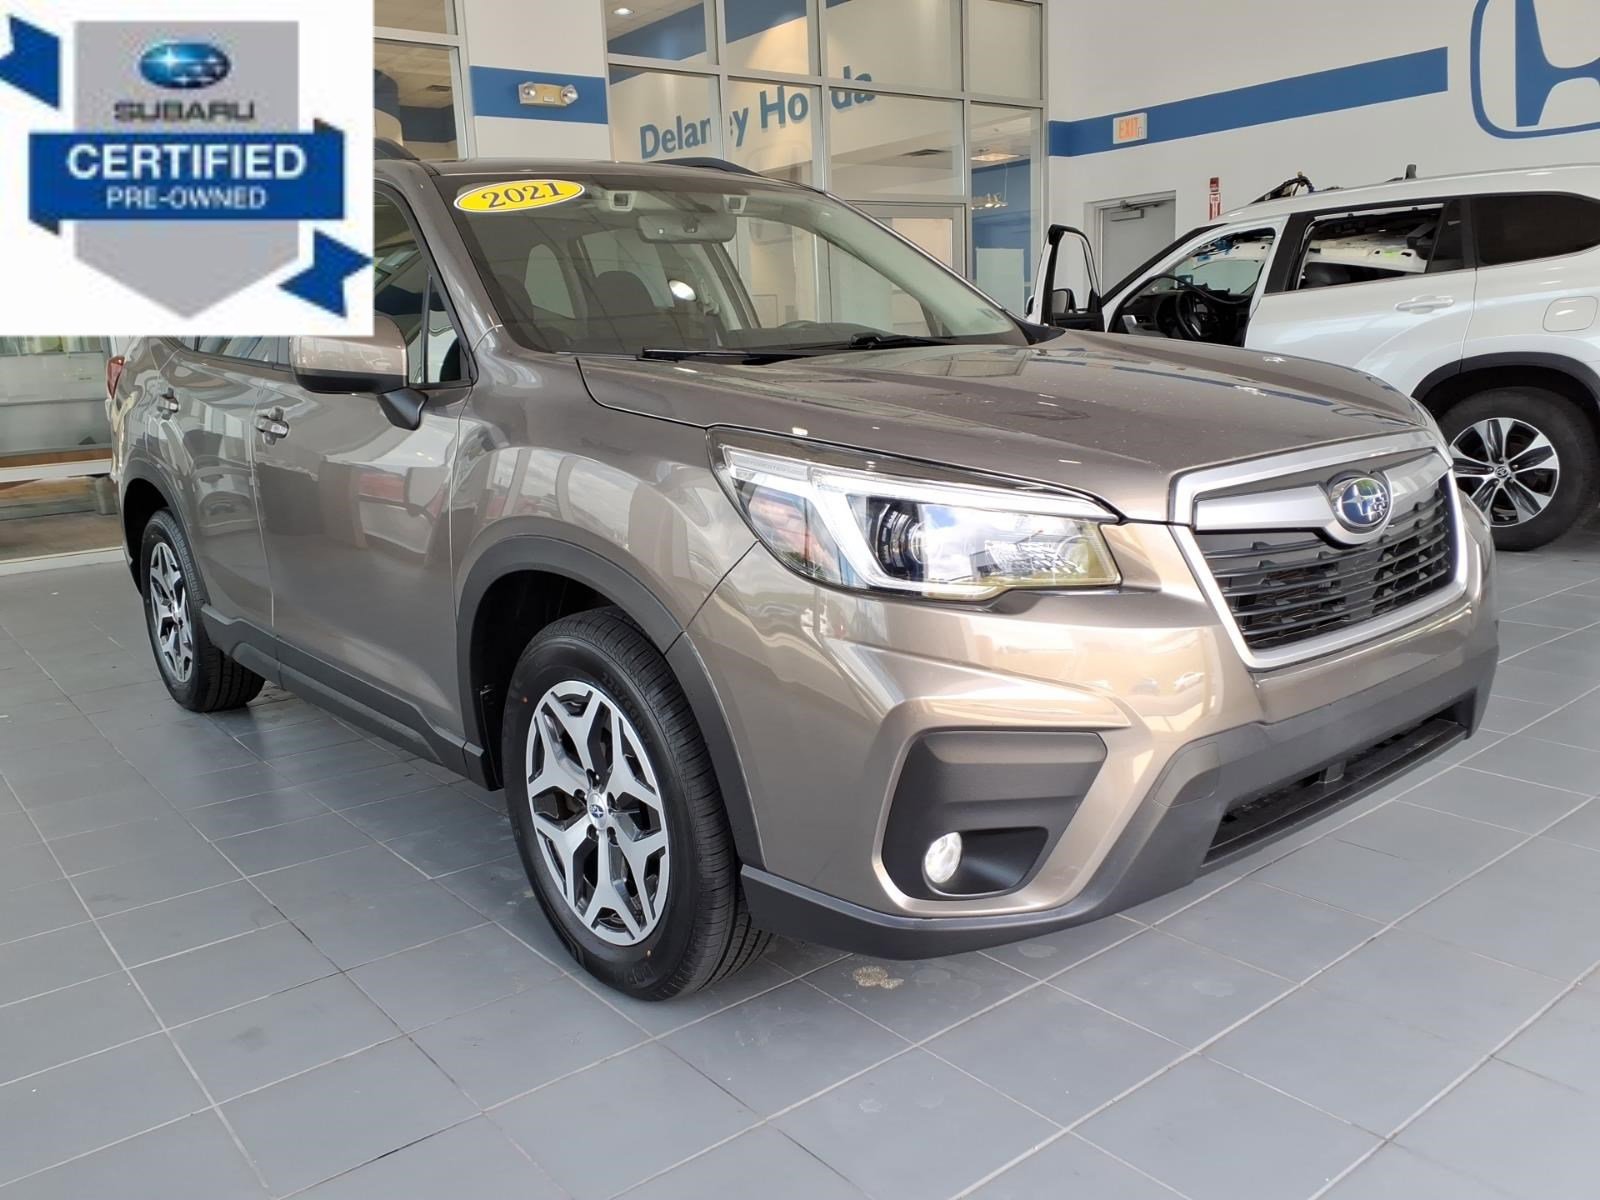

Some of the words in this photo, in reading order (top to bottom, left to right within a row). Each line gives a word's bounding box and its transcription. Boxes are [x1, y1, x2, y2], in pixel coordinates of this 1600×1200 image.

[640, 107, 749, 160] Delany
[759, 65, 876, 129] Hoda
[1118, 116, 1138, 140] EXIT
[481, 182, 563, 208] 2021
